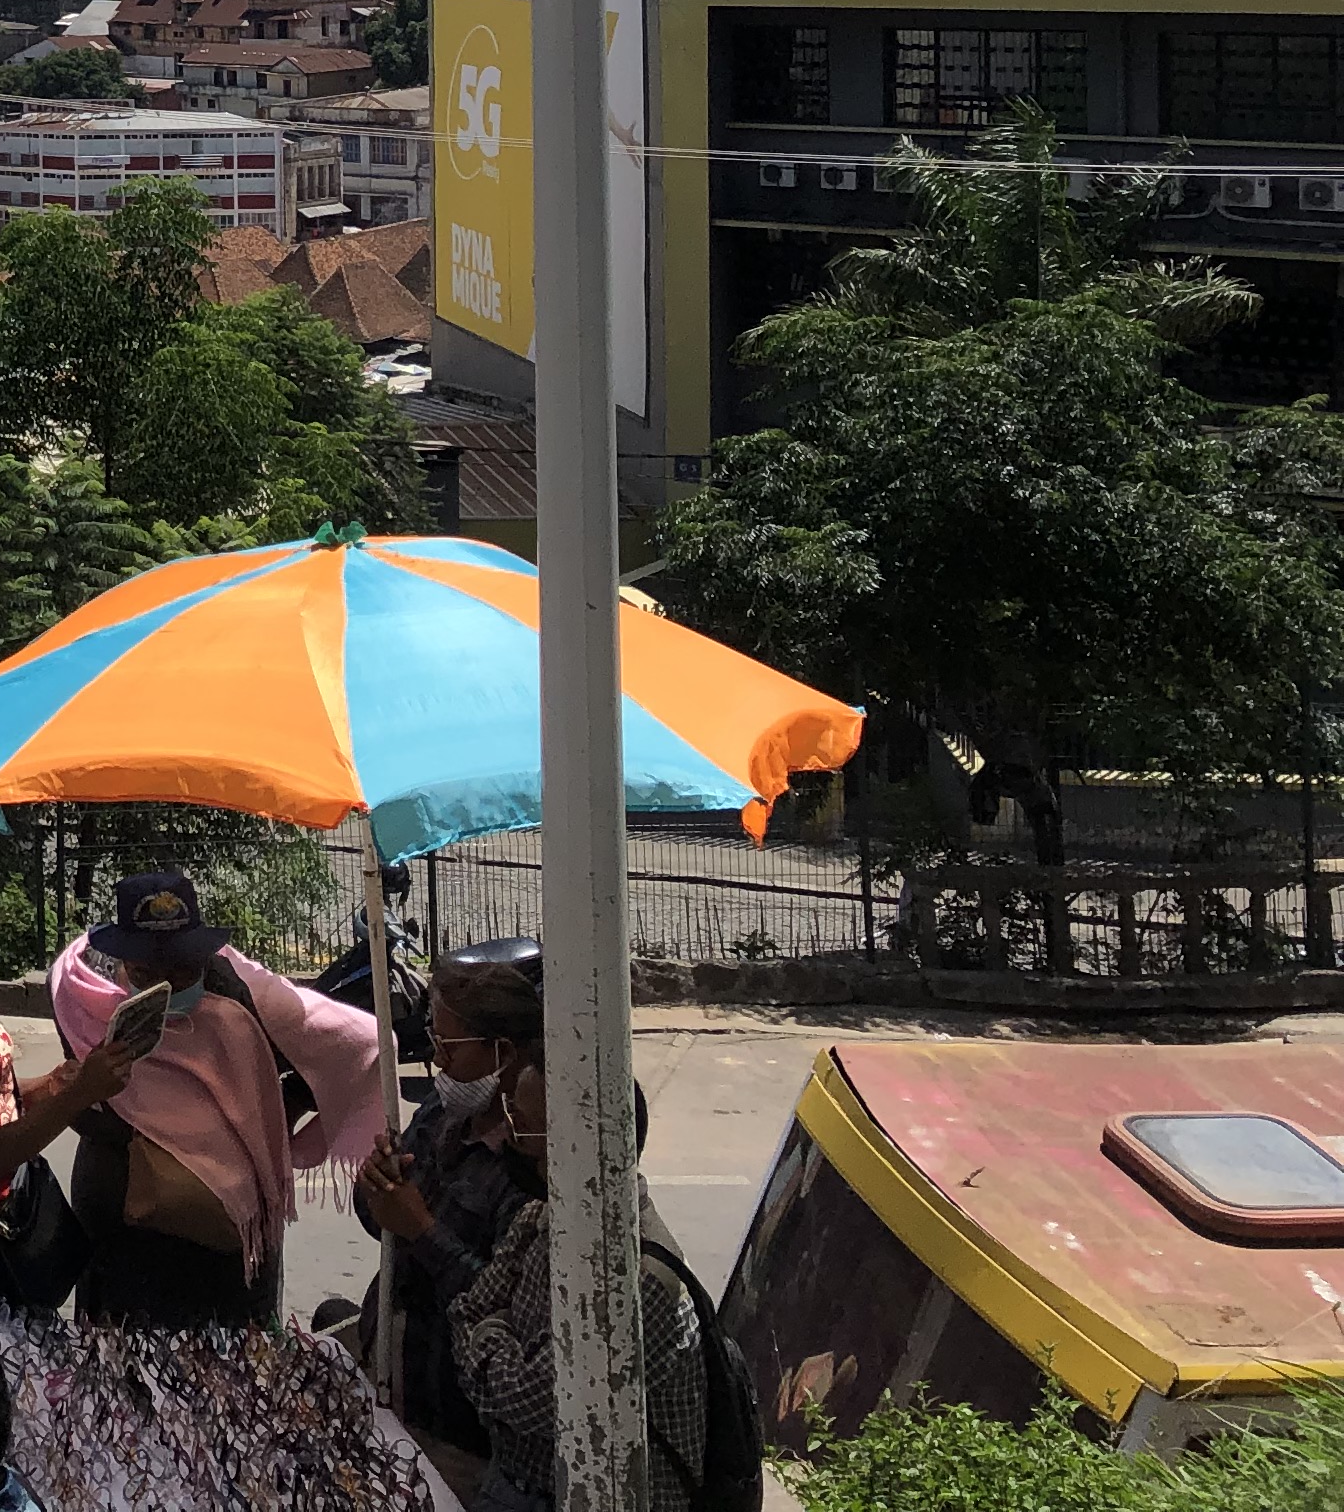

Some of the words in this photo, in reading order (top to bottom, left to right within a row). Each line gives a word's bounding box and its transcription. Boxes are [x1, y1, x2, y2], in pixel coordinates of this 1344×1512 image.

[457, 64, 501, 157] 5G
[452, 222, 494, 278] DYNA
[452, 263, 502, 323] MIQUE
